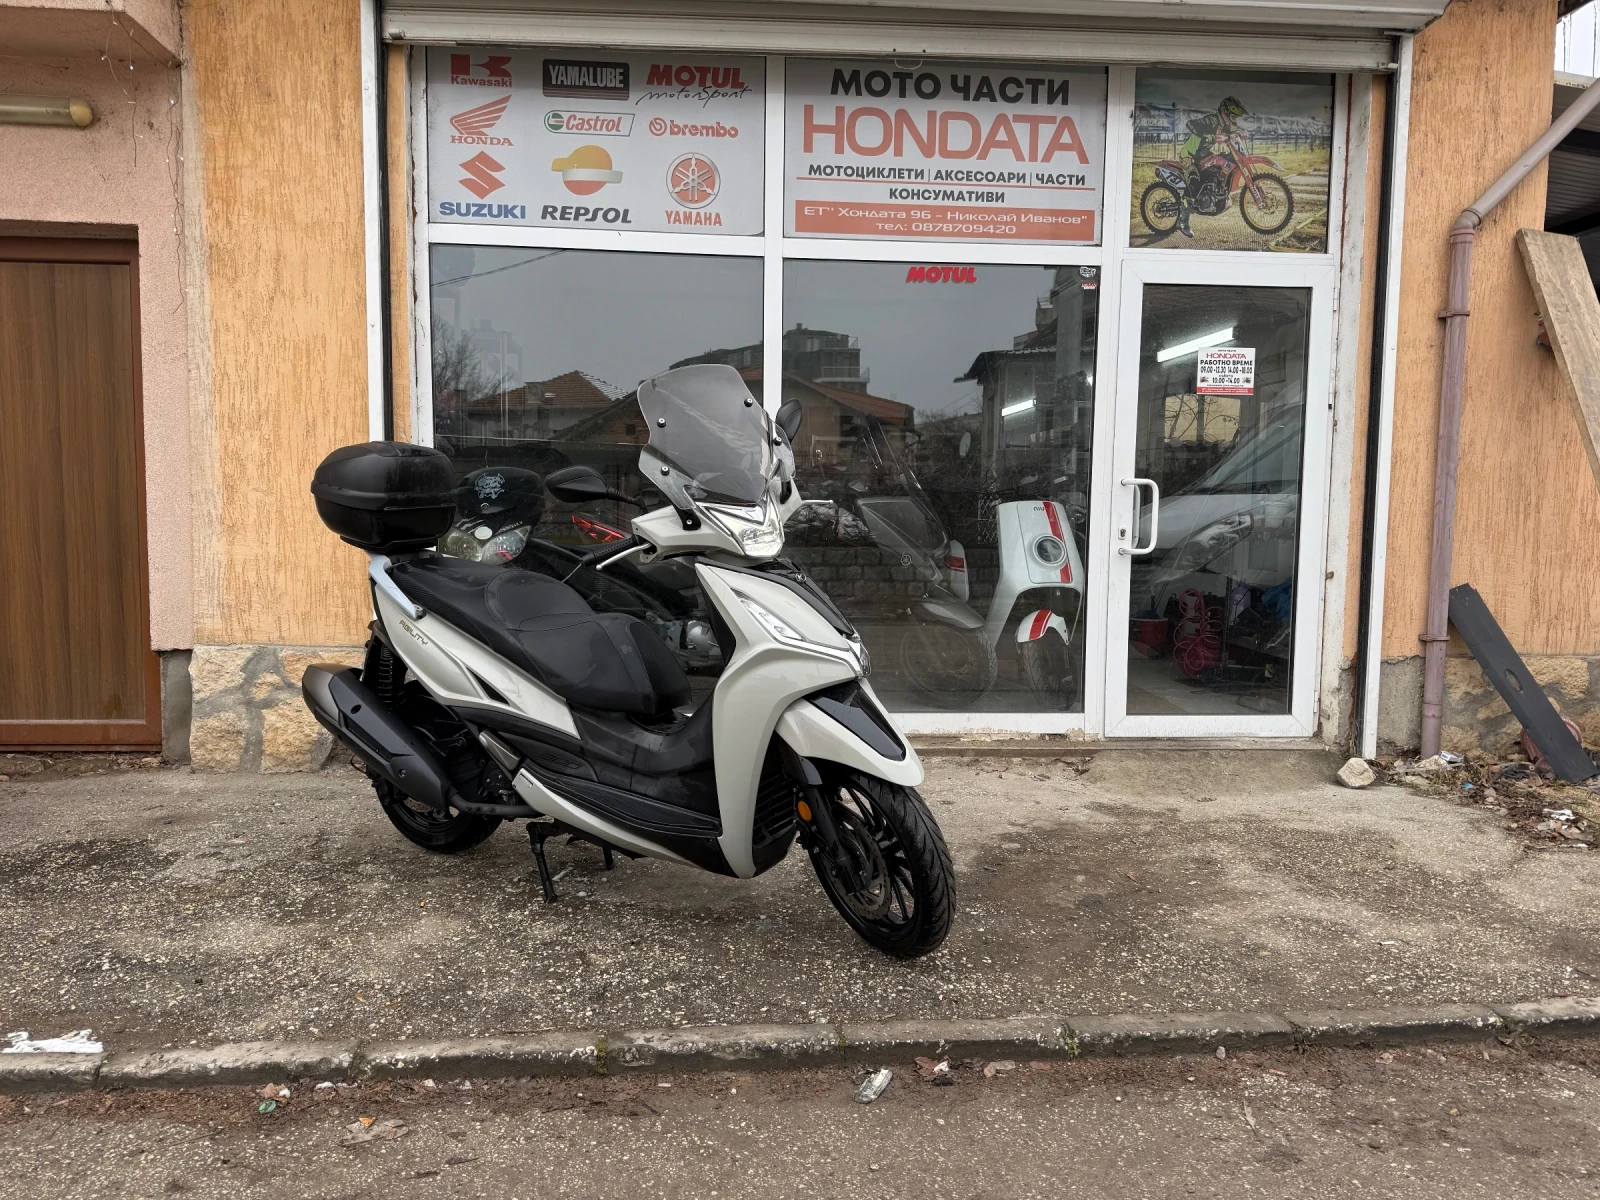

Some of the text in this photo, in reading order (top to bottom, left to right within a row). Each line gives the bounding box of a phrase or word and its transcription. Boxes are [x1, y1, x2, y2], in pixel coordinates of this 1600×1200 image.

[451, 75, 512, 88] Kawasaki
[549, 65, 624, 88] YAMALUBE
[646, 64, 745, 89] MOTUL
[830, 68, 1070, 106] МОТО ЧАСТИ
[565, 114, 622, 133] Castrol
[669, 119, 739, 138] brembo
[450, 135, 514, 147] HONDA
[803, 104, 1090, 165] HONDATA
[808, 164, 1086, 187] МОТОЦИКЛЕТИ АКСЕСОАРИ ЧАСТИ
[889, 188, 1005, 203] КОНСУМАТИВИ
[439, 202, 526, 219] SUZUKI
[541, 205, 632, 224] REPSOL
[665, 210, 723, 227] YAMAHA
[838, 207, 906, 219] Хондата
[911, 210, 931, 220] 96
[947, 211, 1017, 223] Николай
[876, 222, 1017, 234] тел: 0878709420
[905, 266, 977, 284] MOTUL
